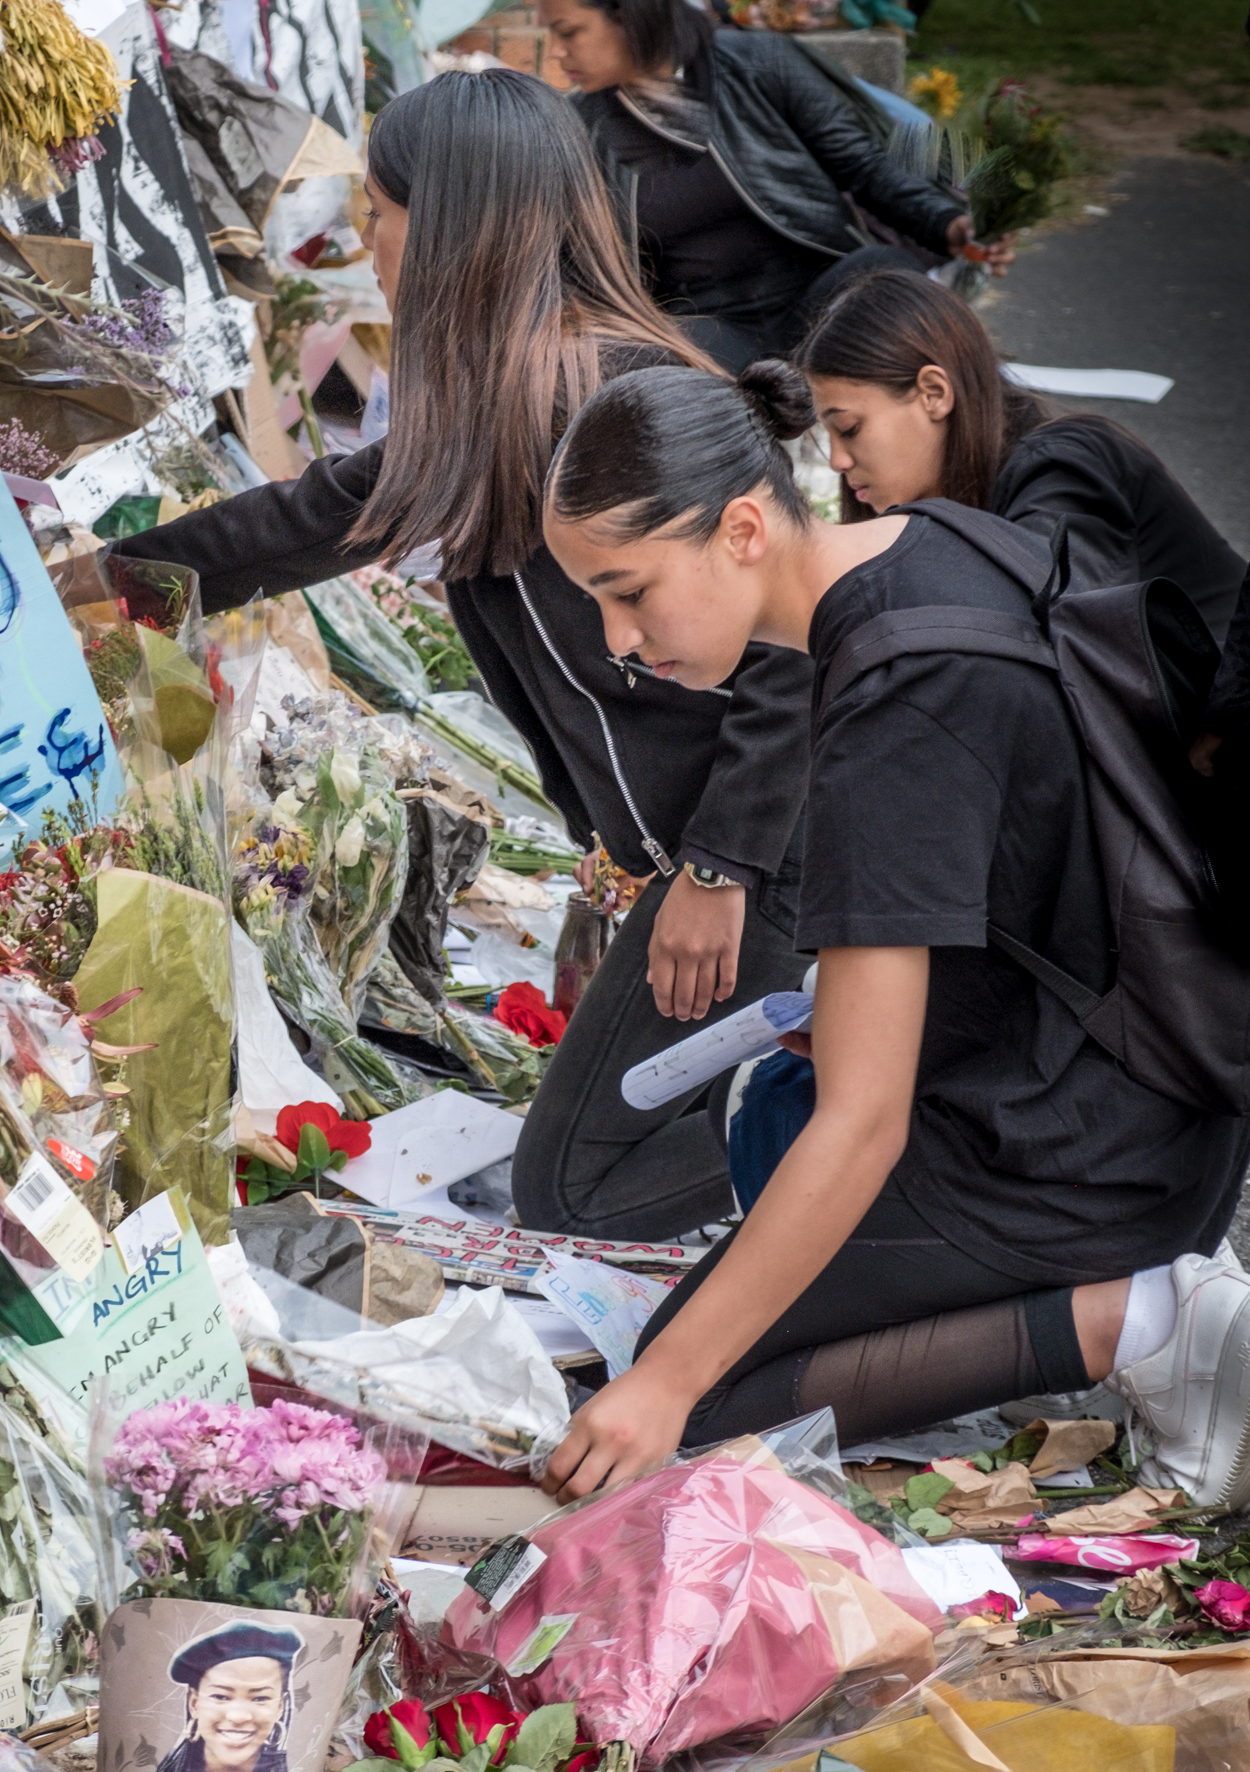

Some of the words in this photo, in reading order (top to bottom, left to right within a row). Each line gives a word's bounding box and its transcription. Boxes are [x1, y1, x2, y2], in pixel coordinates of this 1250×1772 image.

[416, 1215, 685, 1258] WOMEN
[91, 1239, 183, 1327] ANGRY
[104, 1301, 177, 1374] ANGRY
[203, 1303, 224, 1335] OF
